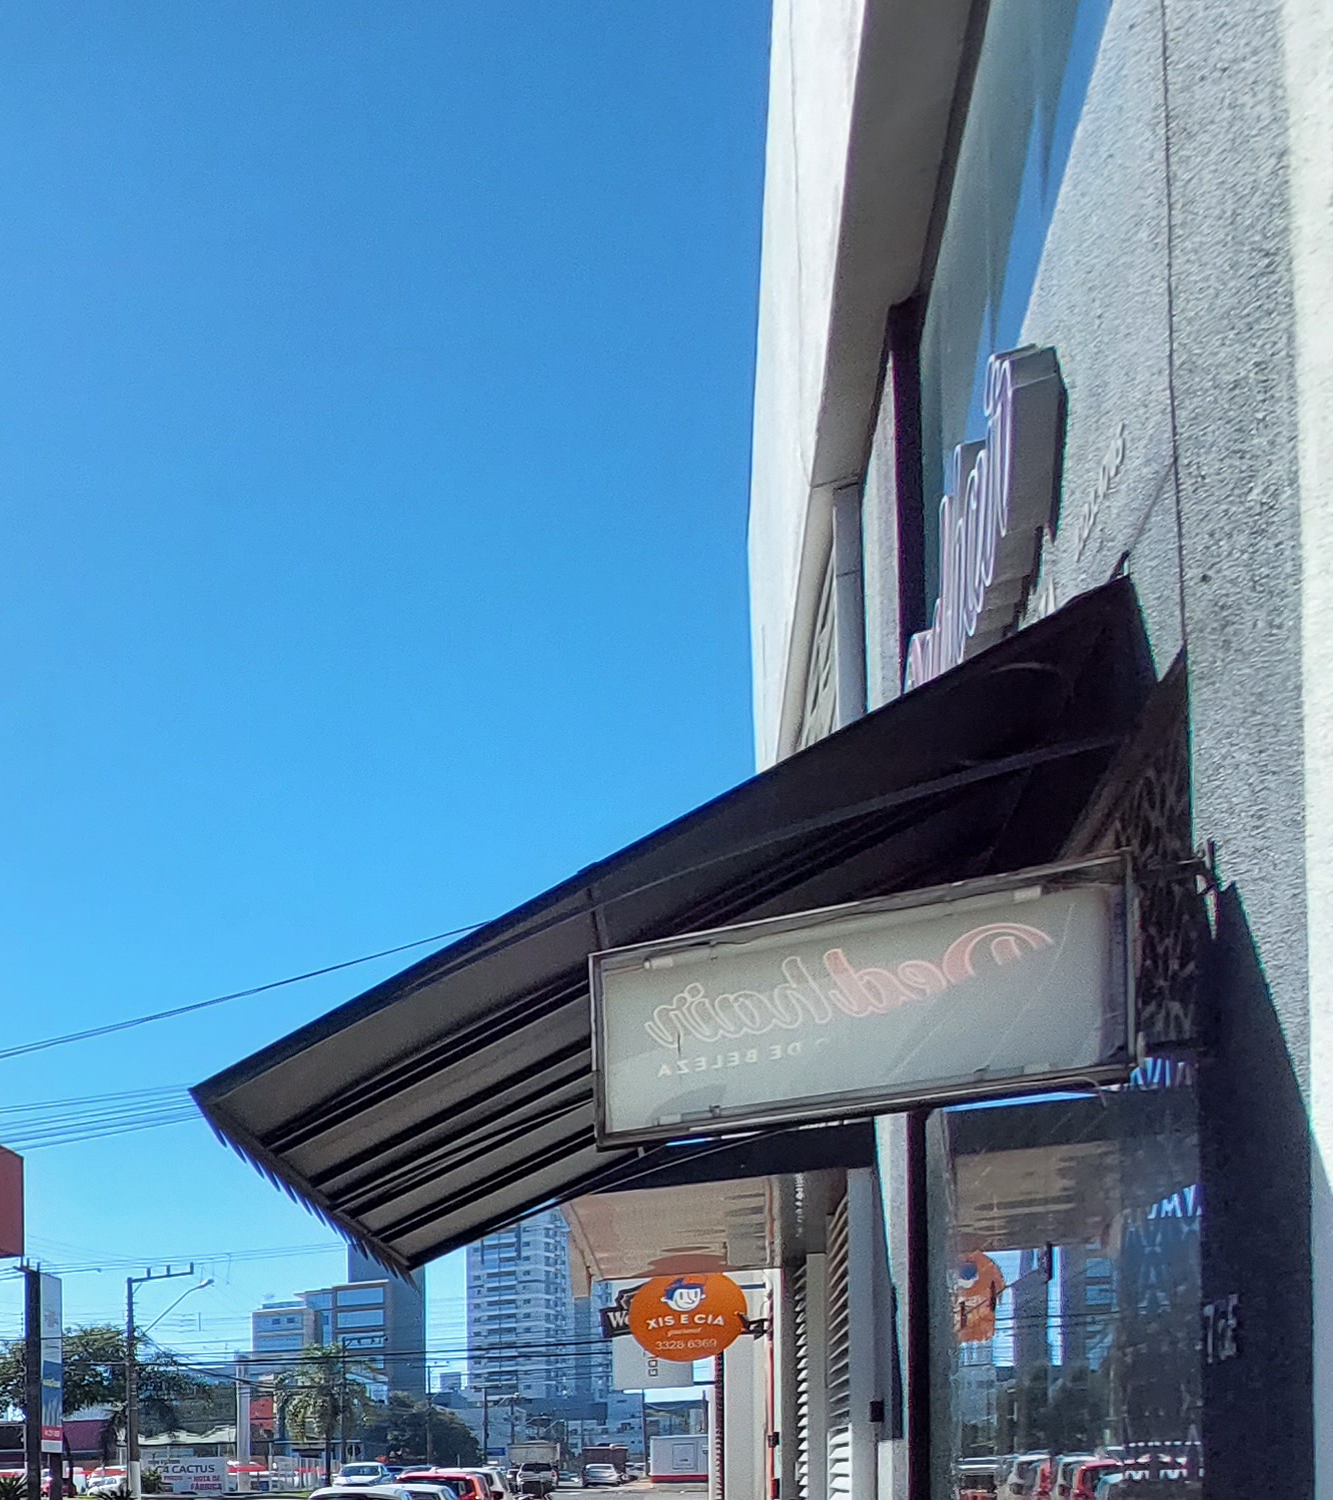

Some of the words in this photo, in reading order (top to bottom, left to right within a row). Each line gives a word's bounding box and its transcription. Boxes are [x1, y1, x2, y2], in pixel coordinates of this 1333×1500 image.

[646, 1315, 675, 1330] XIS
[680, 1313, 689, 1324] E
[693, 1313, 725, 1326] CIA
[172, 1464, 215, 1474] CACTUS
